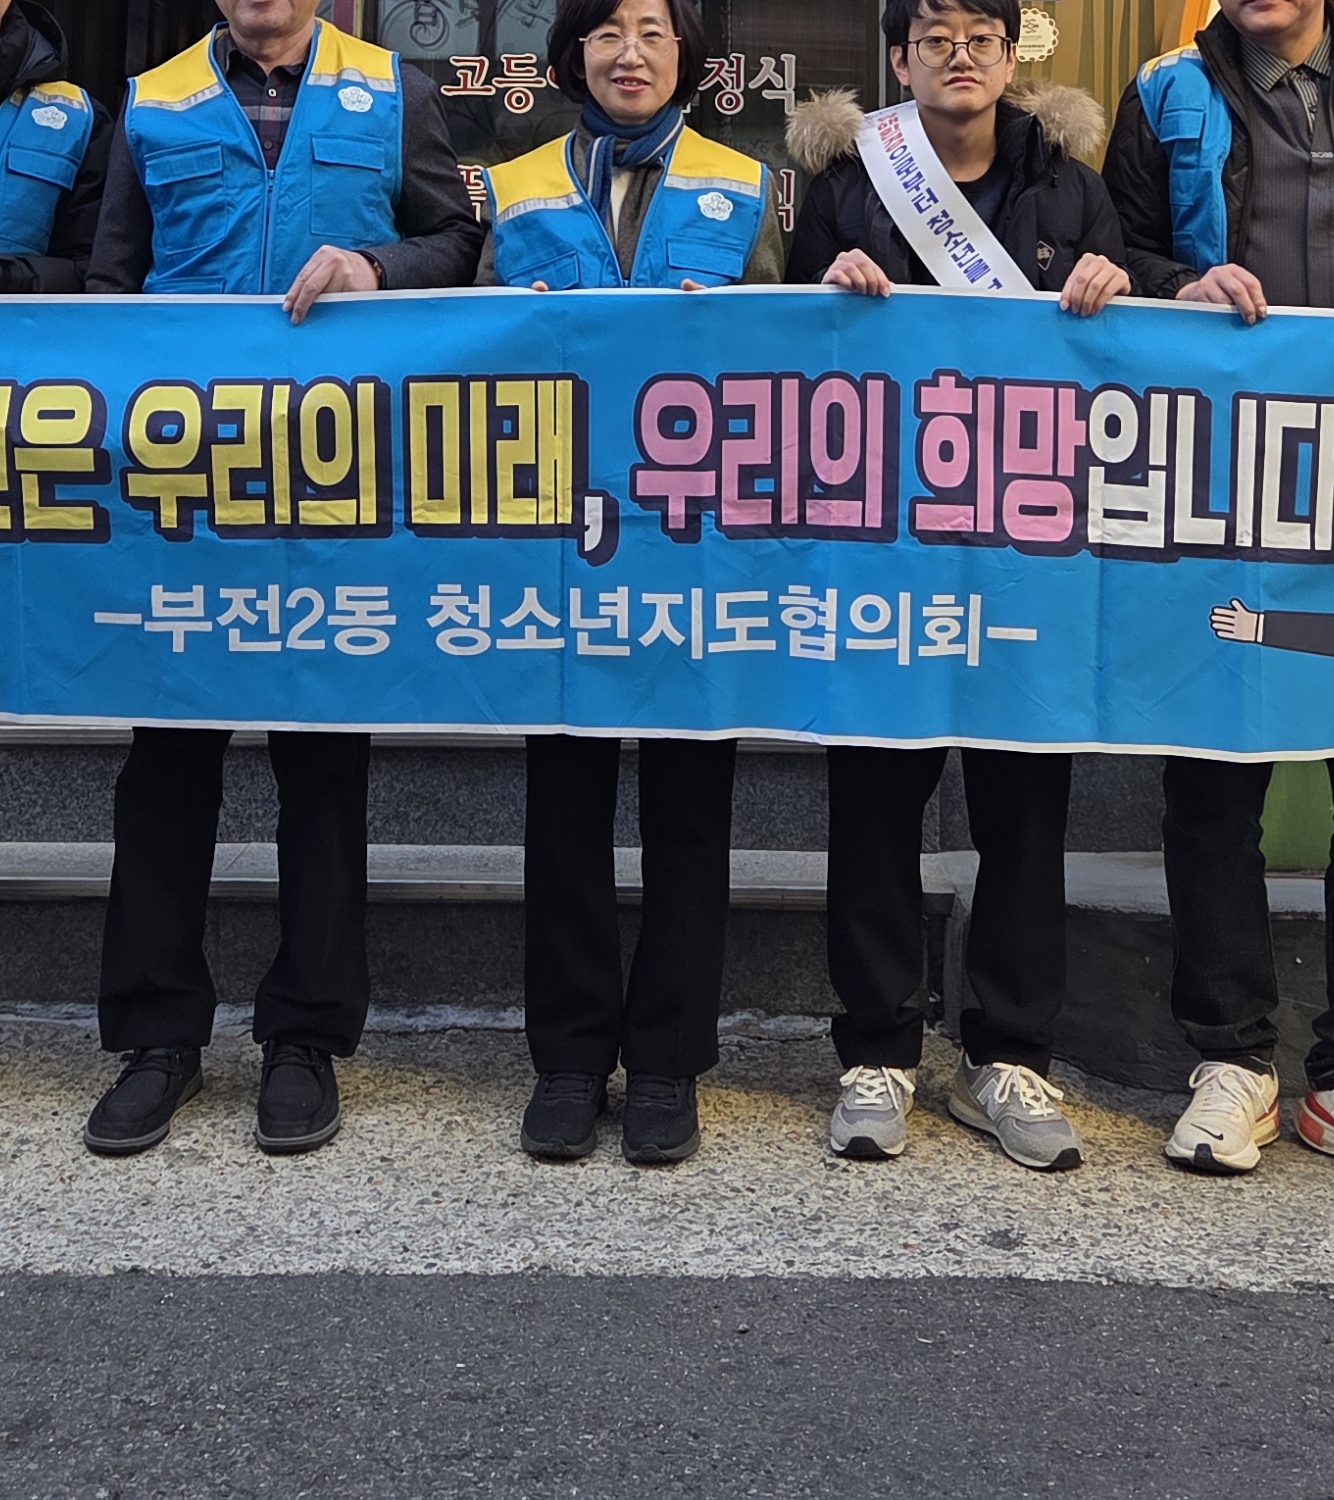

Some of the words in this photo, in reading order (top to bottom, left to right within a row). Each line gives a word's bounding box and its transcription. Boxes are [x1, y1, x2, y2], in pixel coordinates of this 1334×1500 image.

[441, 51, 798, 116] 고등정식
[124, 379, 379, 532] 우리의
[404, 377, 607, 555] 미래,
[631, 373, 887, 533] 우리의
